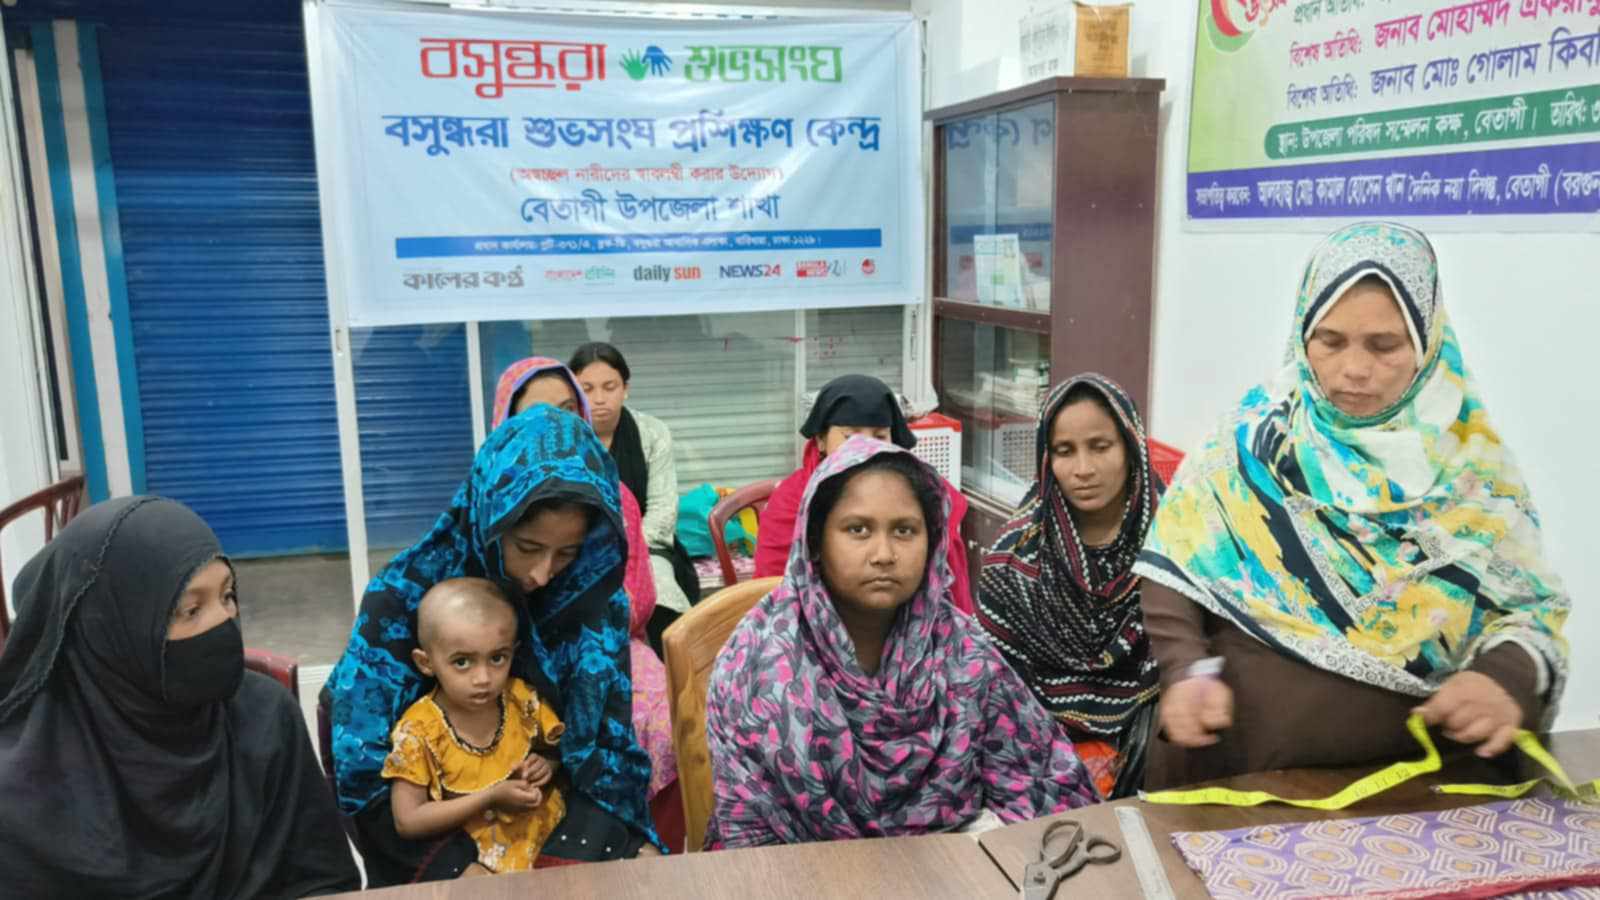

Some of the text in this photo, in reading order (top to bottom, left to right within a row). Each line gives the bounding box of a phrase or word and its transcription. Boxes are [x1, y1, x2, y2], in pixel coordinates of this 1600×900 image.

[1374, 15, 1422, 47] জনাব
[419, 37, 843, 99] বসুন্ধরা শুভসংঘ
[1371, 64, 1417, 95] জনাব
[1423, 58, 1459, 89] মোঃ
[1466, 43, 1541, 83] গোলাম
[382, 108, 881, 156] বসুন্ধরা শুভসংঘ প্রশিক্ষণ কেন্দ্র
[1505, 162, 1551, 200] বেতাগী
[521, 188, 607, 223] বেতাগী
[615, 189, 720, 222] উপজেলা
[403, 270, 479, 290] কালের
[633, 265, 671, 282] daily
[674, 266, 701, 280] sun
[719, 264, 783, 279] NEWS24
